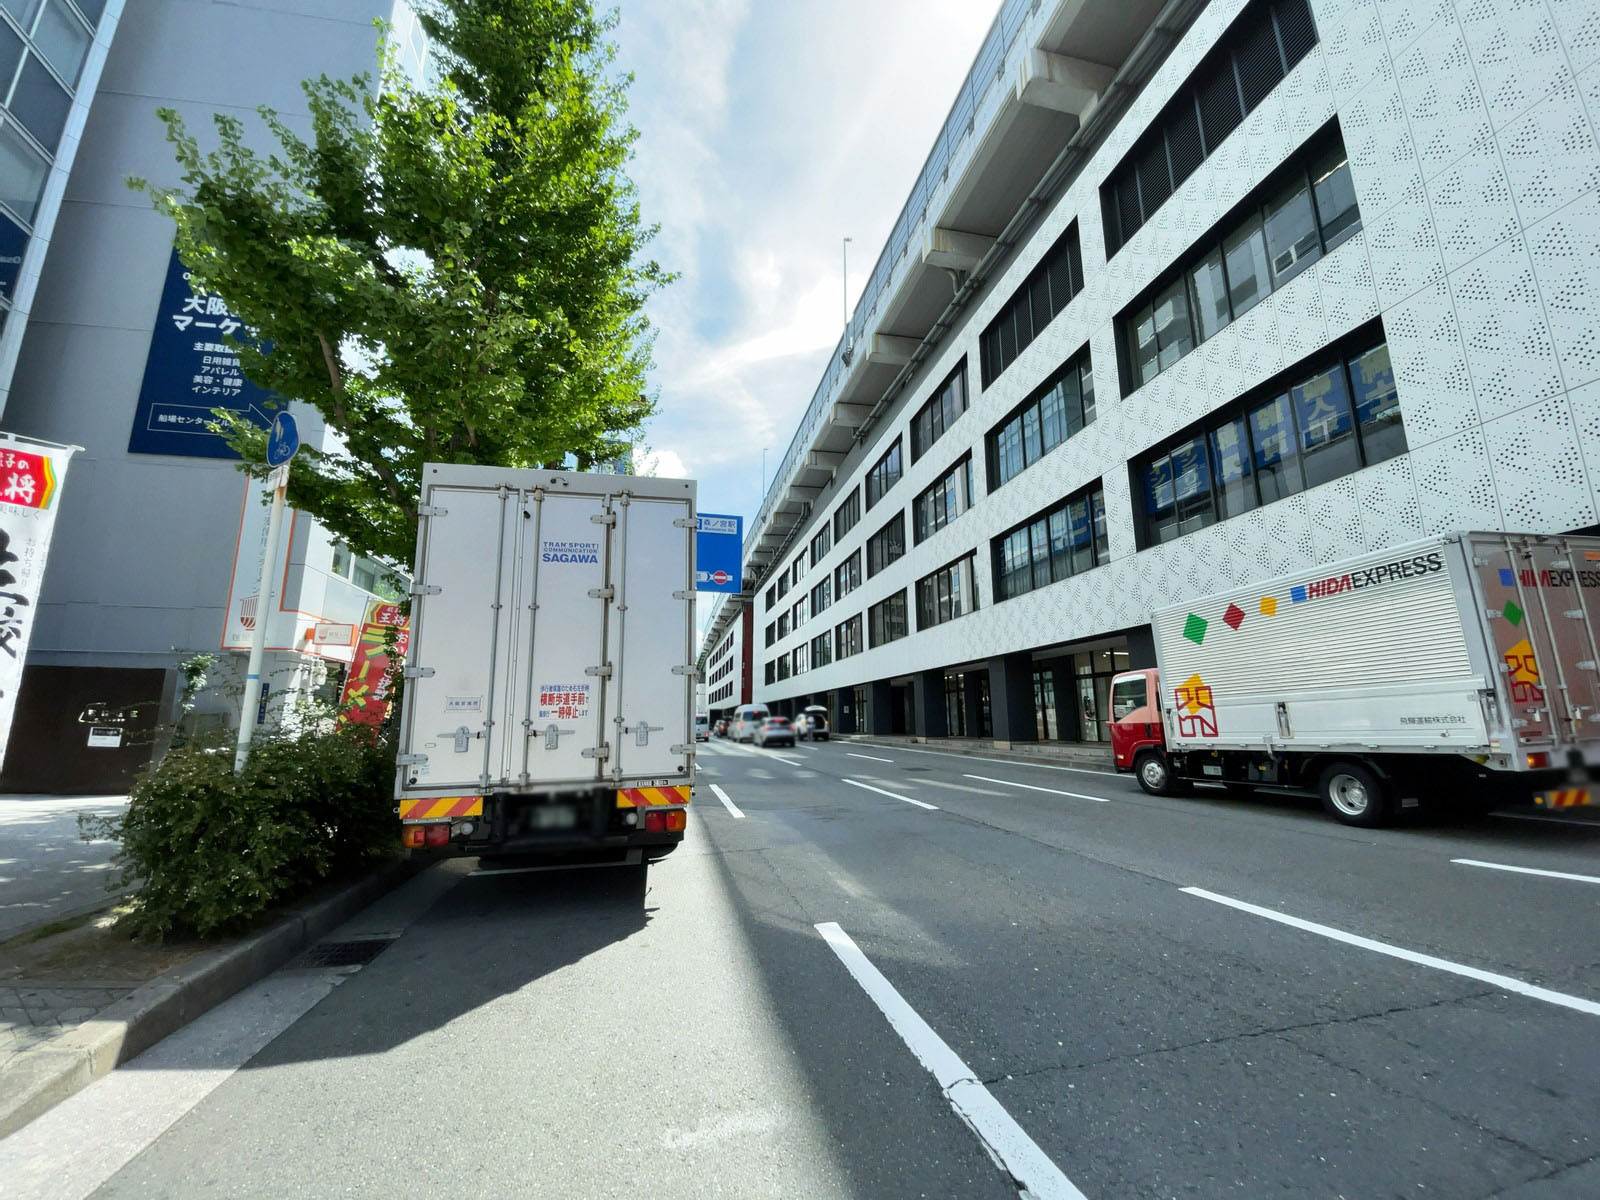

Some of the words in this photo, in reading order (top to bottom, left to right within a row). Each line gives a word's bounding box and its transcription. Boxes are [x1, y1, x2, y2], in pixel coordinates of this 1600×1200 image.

[182, 295, 241, 318] 大阪
[192, 385, 241, 396] インテリア
[542, 553, 598, 564] SAGAWA
